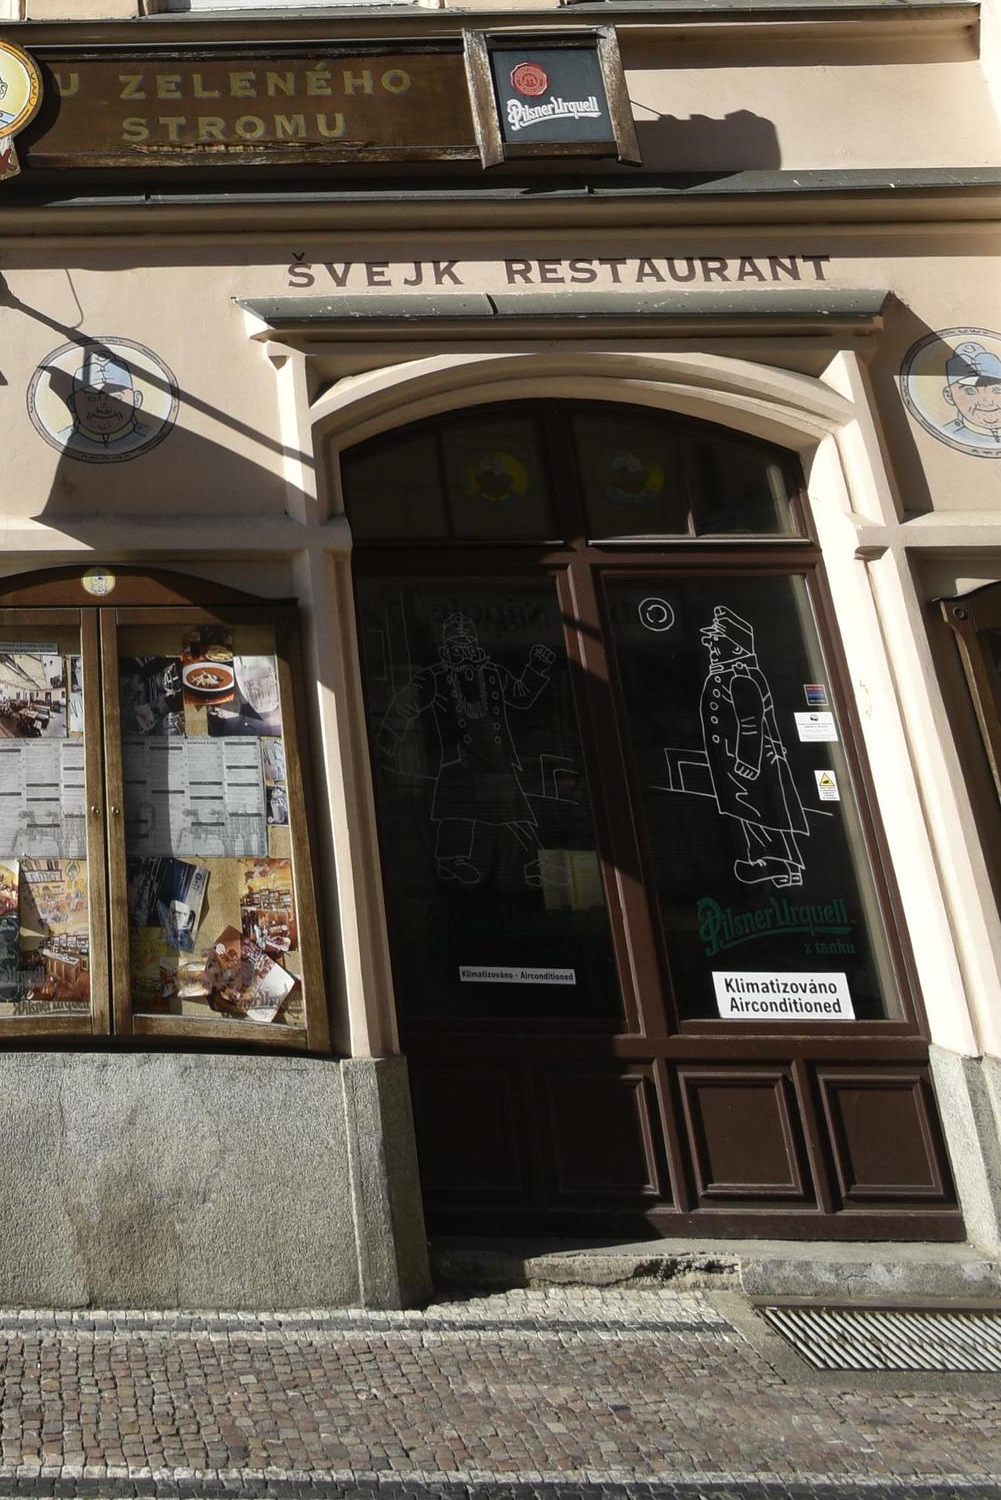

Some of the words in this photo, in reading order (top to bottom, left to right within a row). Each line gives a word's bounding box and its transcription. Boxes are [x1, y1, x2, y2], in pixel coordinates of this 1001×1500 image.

[55, 71, 82, 96] U
[117, 60, 413, 100] ZELENÉHO
[121, 112, 347, 140] STROMU
[506, 99, 555, 131] Pilsner
[550, 96, 600, 119] Urquell
[287, 252, 463, 287] ŠVEJK
[504, 254, 832, 284] RESTAURANT
[698, 897, 773, 956] Pilsner
[769, 897, 848, 937] Urquell
[815, 938, 856, 954] tanku
[461, 970, 513, 979] Klimatizováno
[520, 971, 574, 980] Airconditioned
[724, 978, 837, 994] Klimatizováno
[730, 997, 842, 1013] Airconditioned
